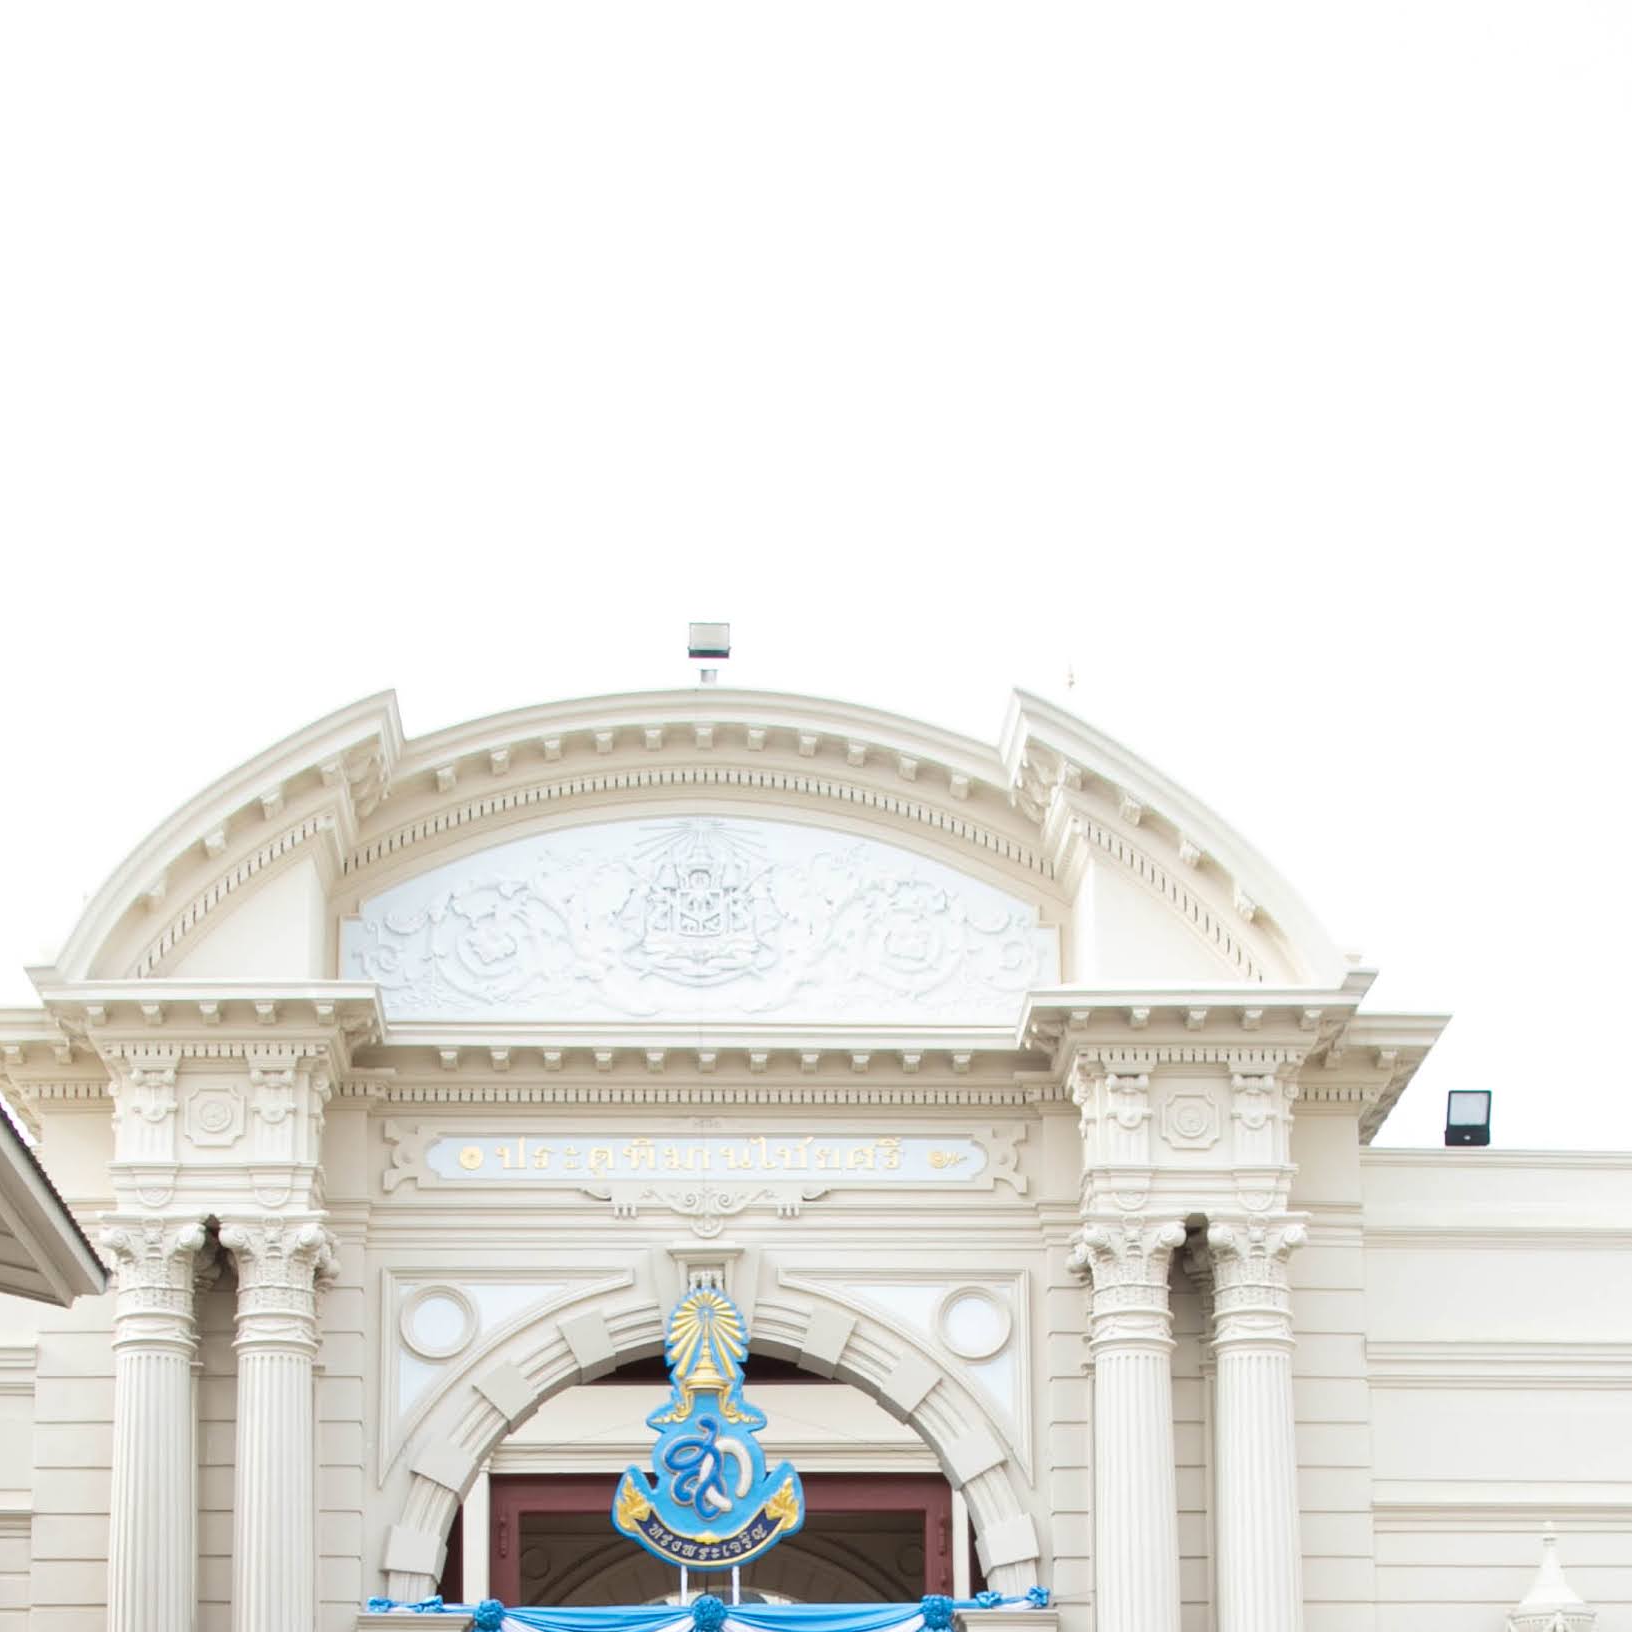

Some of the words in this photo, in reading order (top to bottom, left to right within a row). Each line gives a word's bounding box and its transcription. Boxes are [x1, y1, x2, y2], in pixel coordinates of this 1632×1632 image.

[648, 1522, 768, 1561] ทรงพระเจริญ
